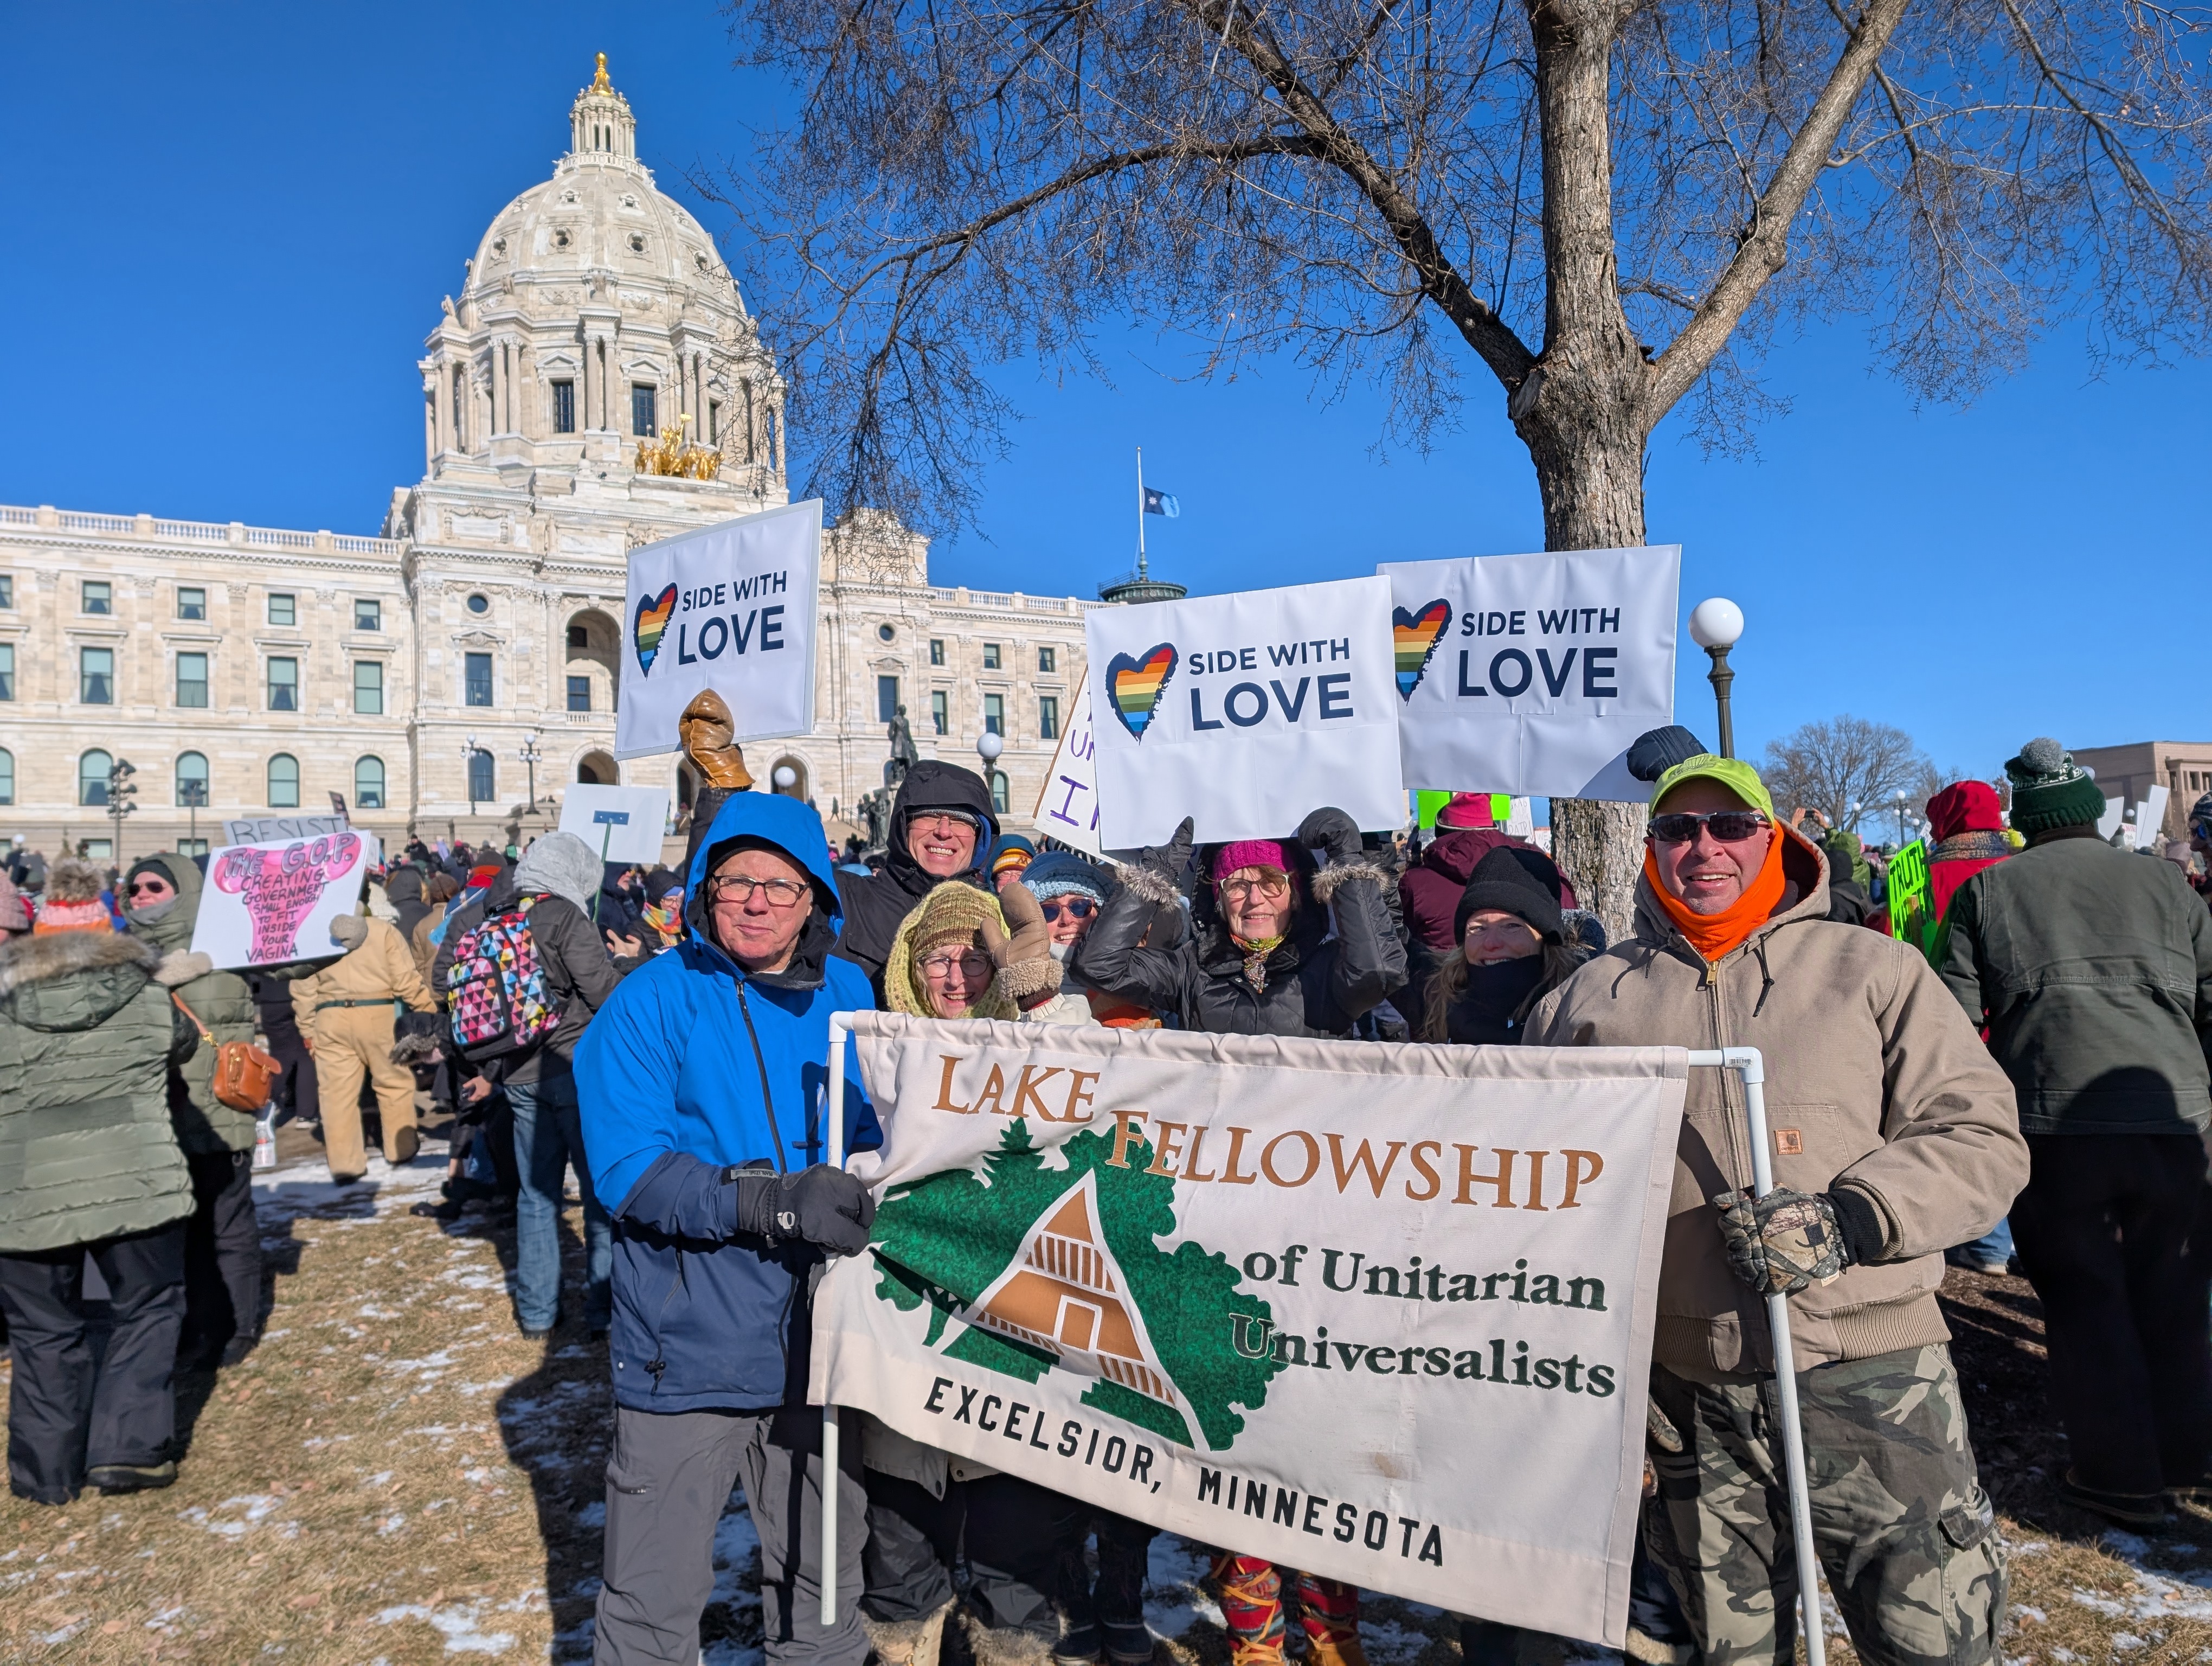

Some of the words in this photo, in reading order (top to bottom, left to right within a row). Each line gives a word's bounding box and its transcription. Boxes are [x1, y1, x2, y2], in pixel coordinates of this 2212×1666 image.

[682, 583, 726, 612] SIDE
[733, 570, 787, 601] WITH
[678, 604, 785, 665] LOVE
[1460, 611, 1526, 636] SIDE
[1538, 607, 1621, 635] WITH
[1189, 648, 1256, 676] SIDE
[1267, 637, 1350, 667] WITH
[1458, 647, 1618, 698] LOVE
[1191, 672, 1354, 732] LOVE
[230, 817, 342, 845] RESIST
[220, 847, 267, 879] THE
[281, 832, 357, 875] G.O.P.
[1889, 844, 1925, 904] TRUTH
[240, 868, 325, 892] CREATING
[242, 881, 330, 905] GOVERNMENT
[253, 903, 280, 914] SMALL
[286, 894, 319, 909] ENOUGH
[258, 915, 272, 924] TO
[276, 909, 299, 921] FIT
[258, 920, 297, 935] INSIDE
[261, 933, 290, 946] YOUR
[246, 942, 298, 963] VAGINA
[931, 1054, 1101, 1123] LAKE
[1105, 1110, 1604, 1212] FELLOWSHIP
[1243, 1244, 1308, 1287] of
[1321, 1248, 1609, 1312] Unitarian
[1229, 1312, 1616, 1399] Universalists
[923, 1376, 1162, 1495] EXCELSIOR,
[1197, 1467, 1444, 1567] MINNESOTA
